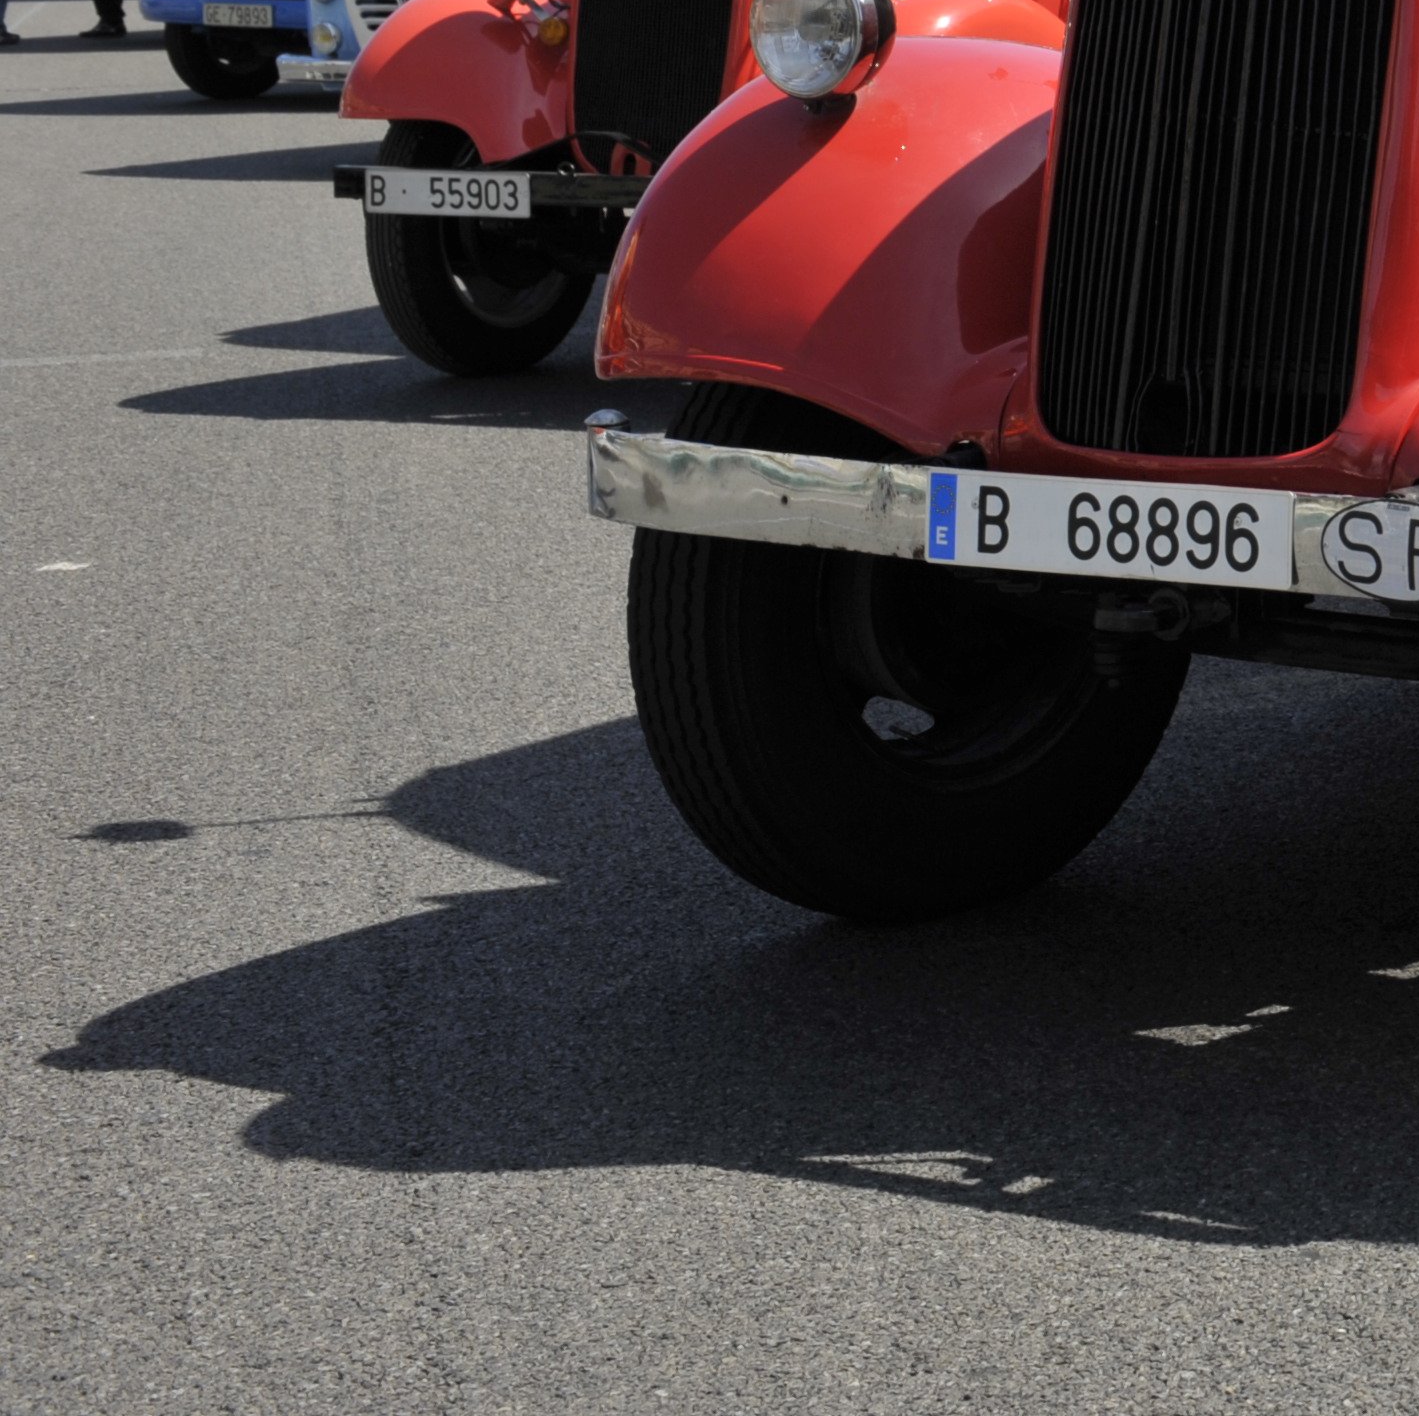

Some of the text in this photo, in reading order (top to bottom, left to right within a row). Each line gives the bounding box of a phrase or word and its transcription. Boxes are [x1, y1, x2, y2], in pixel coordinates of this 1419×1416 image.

[370, 175, 519, 211] B 55903
[935, 526, 948, 545] E
[977, 485, 1259, 573] B 68896
